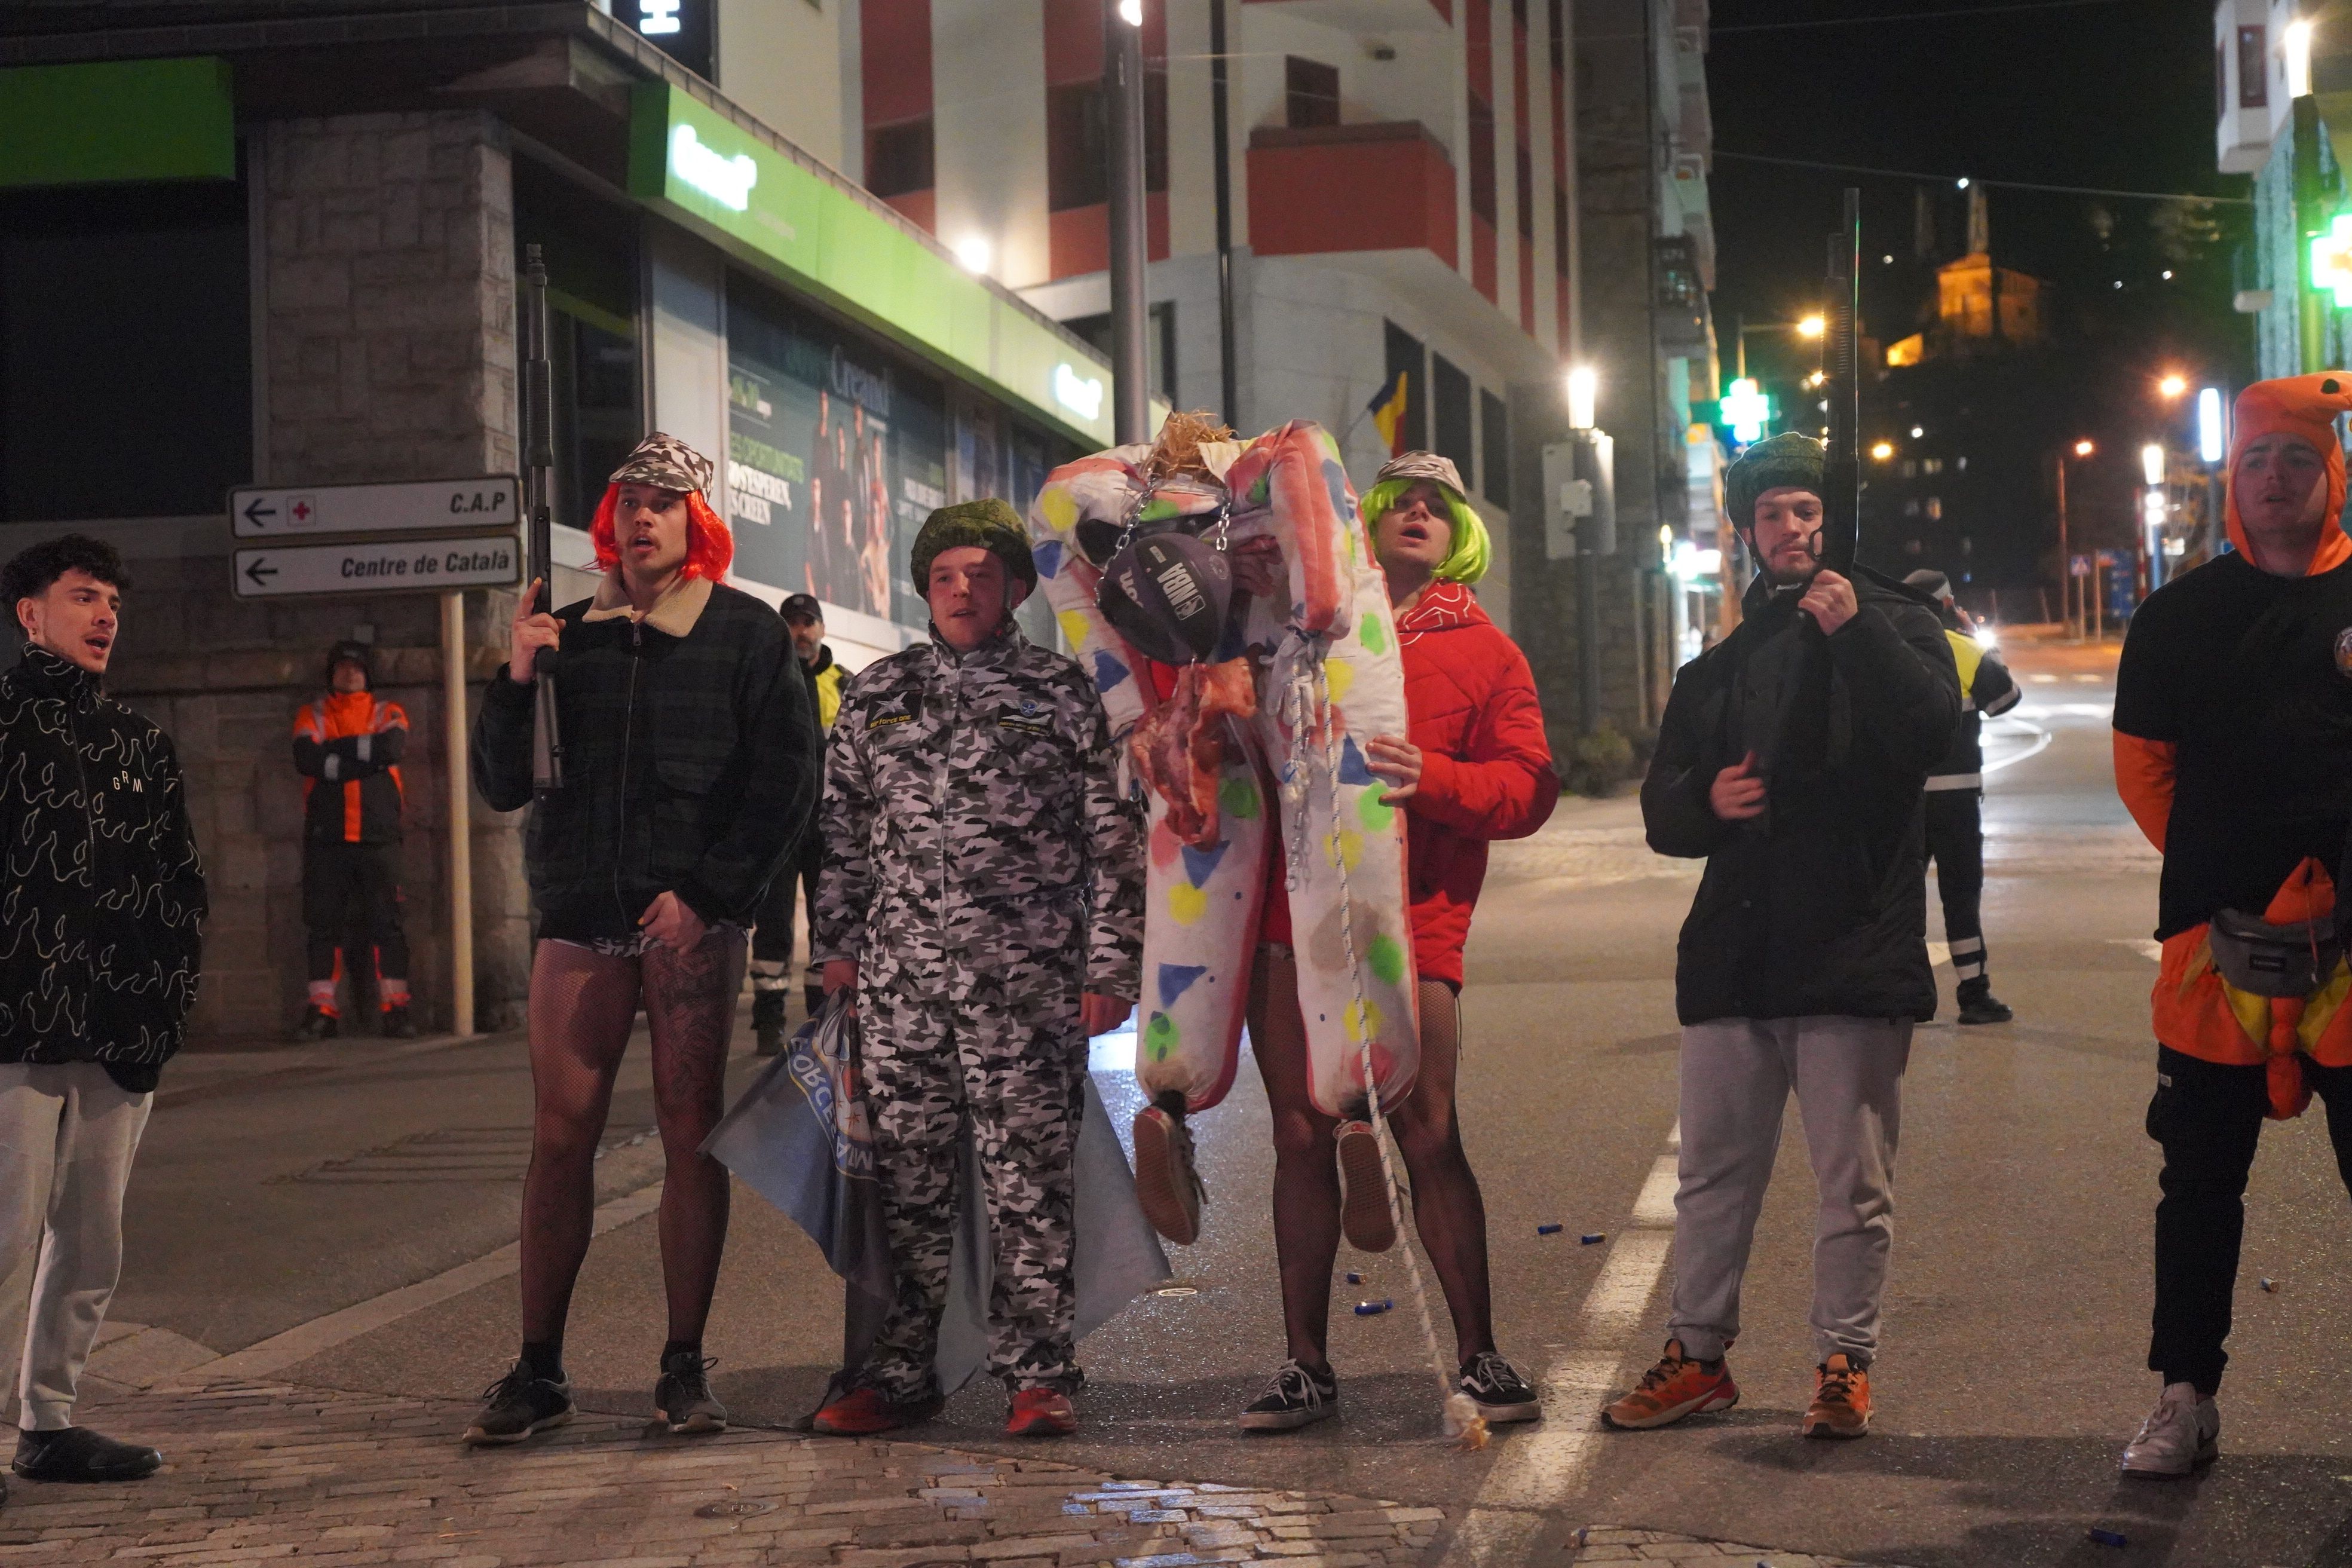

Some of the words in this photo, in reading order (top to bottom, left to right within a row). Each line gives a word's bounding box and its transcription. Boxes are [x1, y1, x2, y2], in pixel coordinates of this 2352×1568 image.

[451, 493, 505, 513] C.A.P
[342, 557, 406, 578] Centre
[414, 555, 437, 574] de
[445, 550, 508, 572] Català
[1157, 562, 1198, 606] NBA
